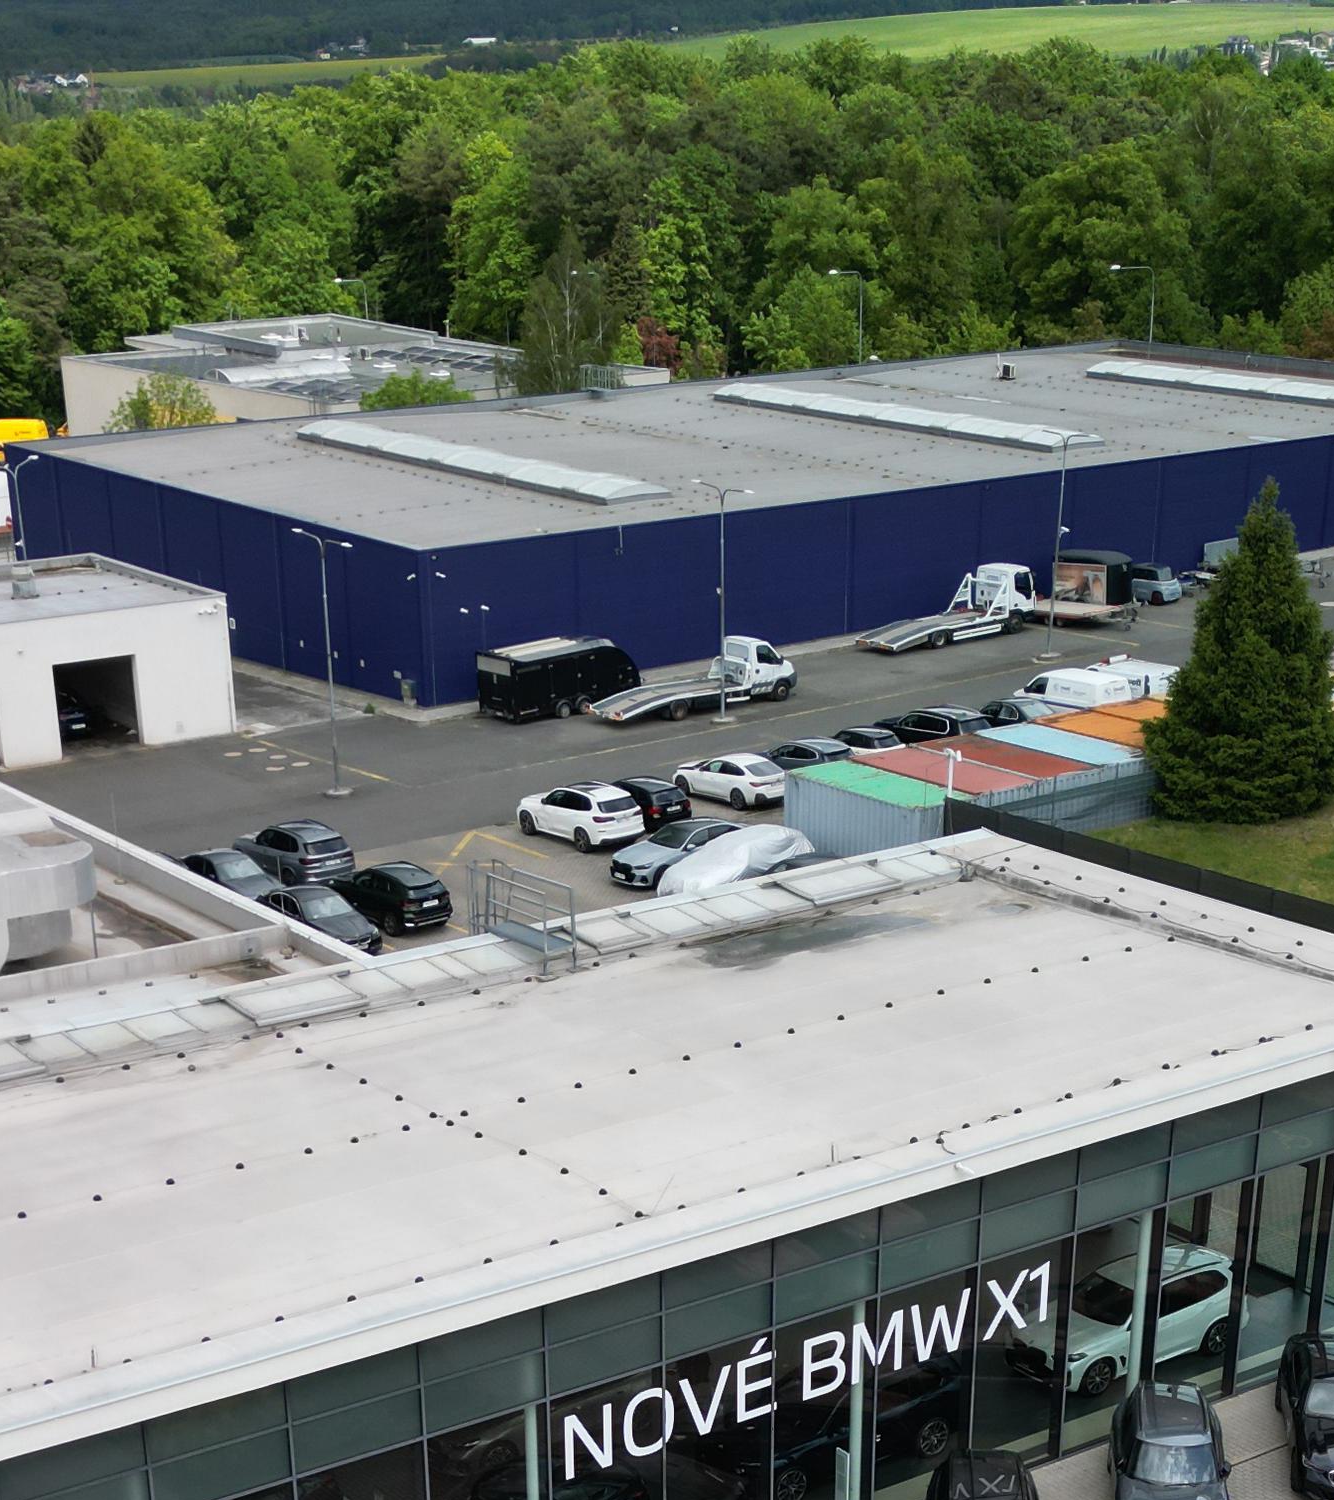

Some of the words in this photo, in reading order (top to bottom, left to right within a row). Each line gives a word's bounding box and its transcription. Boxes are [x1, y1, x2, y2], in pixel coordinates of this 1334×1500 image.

[565, 1336, 777, 1481] NOVÉ
[801, 1287, 971, 1403] BMW
[982, 1260, 1052, 1342] X1
